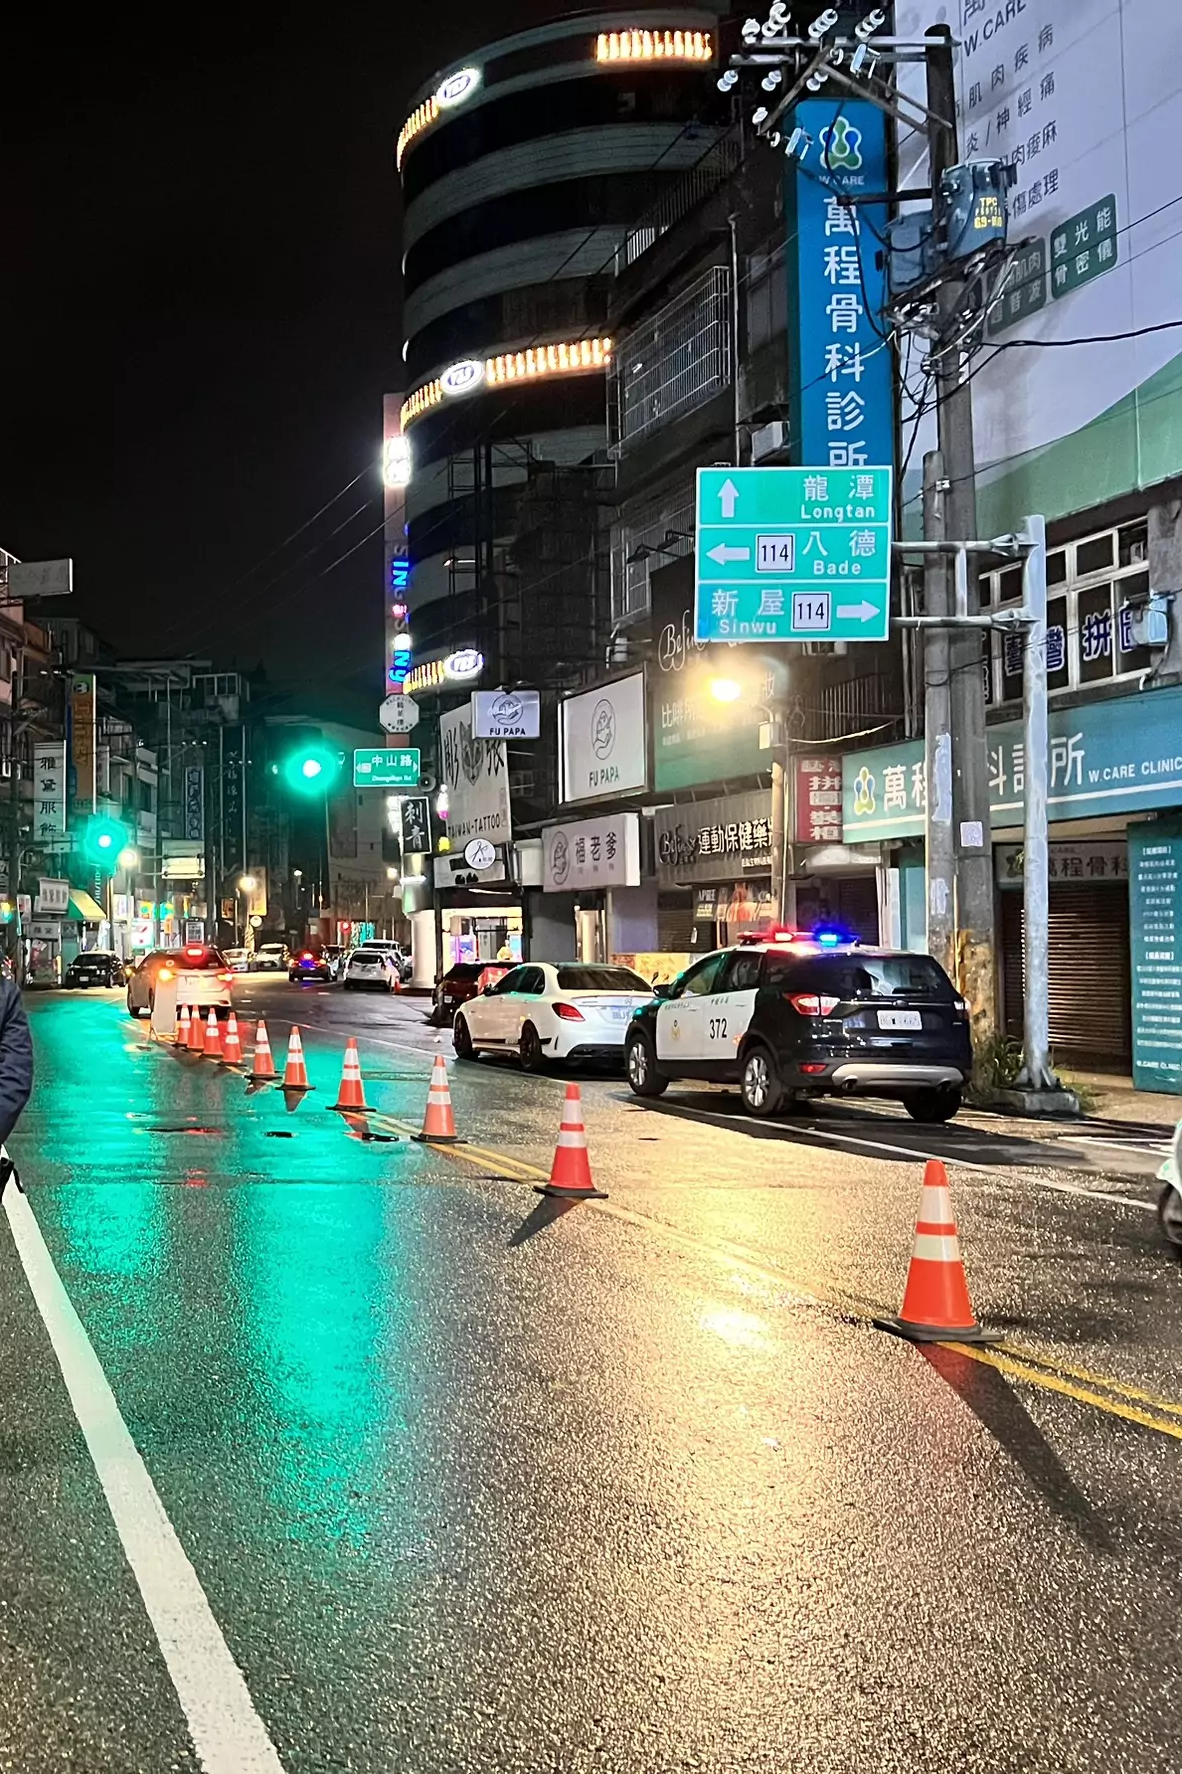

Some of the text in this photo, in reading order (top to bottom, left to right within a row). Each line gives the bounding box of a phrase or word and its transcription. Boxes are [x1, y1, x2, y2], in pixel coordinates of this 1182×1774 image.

[956, 24, 1054, 117] 肌肉疾病
[823, 196, 869, 465] 萬程骨科診所
[803, 474, 874, 501] 龍潭
[800, 504, 875, 523] Longtan
[760, 544, 790, 565] 114
[802, 530, 876, 557] 八德
[813, 560, 862, 576] Bade
[711, 589, 785, 617] 新屋
[797, 601, 825, 624] 114
[719, 619, 777, 635] Sinwu
[489, 728, 526, 736] FU PAPA
[371, 754, 412, 767] 中山路
[589, 766, 620, 788] FU PAPA
[1089, 763, 1135, 783] W.CARE
[405, 801, 425, 850] 刺青
[448, 812, 501, 838] TAIWAN-TATTOO
[575, 831, 617, 865] 福老爹
[709, 1018, 727, 1040] 372
